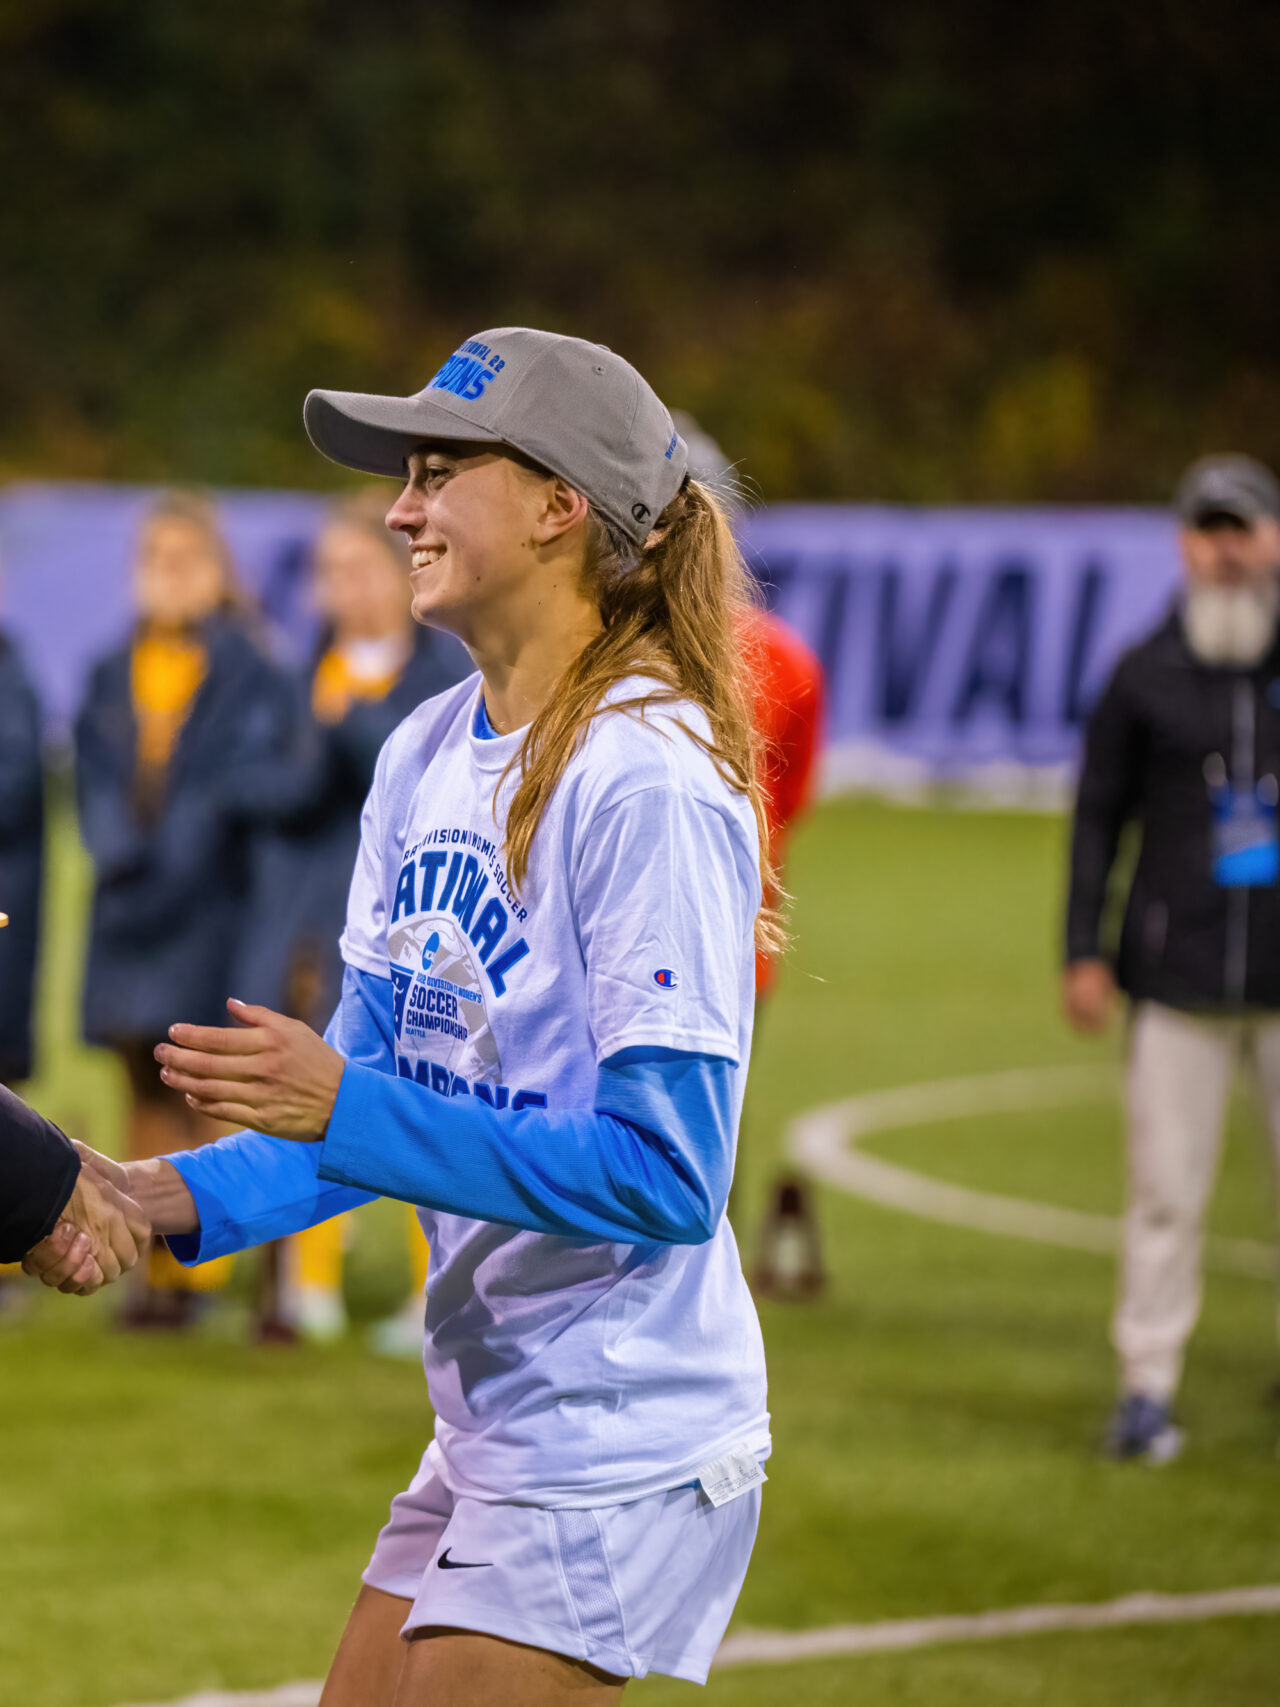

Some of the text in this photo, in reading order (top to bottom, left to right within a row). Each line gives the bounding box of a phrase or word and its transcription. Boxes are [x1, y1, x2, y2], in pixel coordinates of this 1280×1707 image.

[391, 850, 530, 998] ATIONAL
[409, 984, 458, 1020] SOCCER
[406, 1009, 468, 1042] CHAMPIONSHIP
